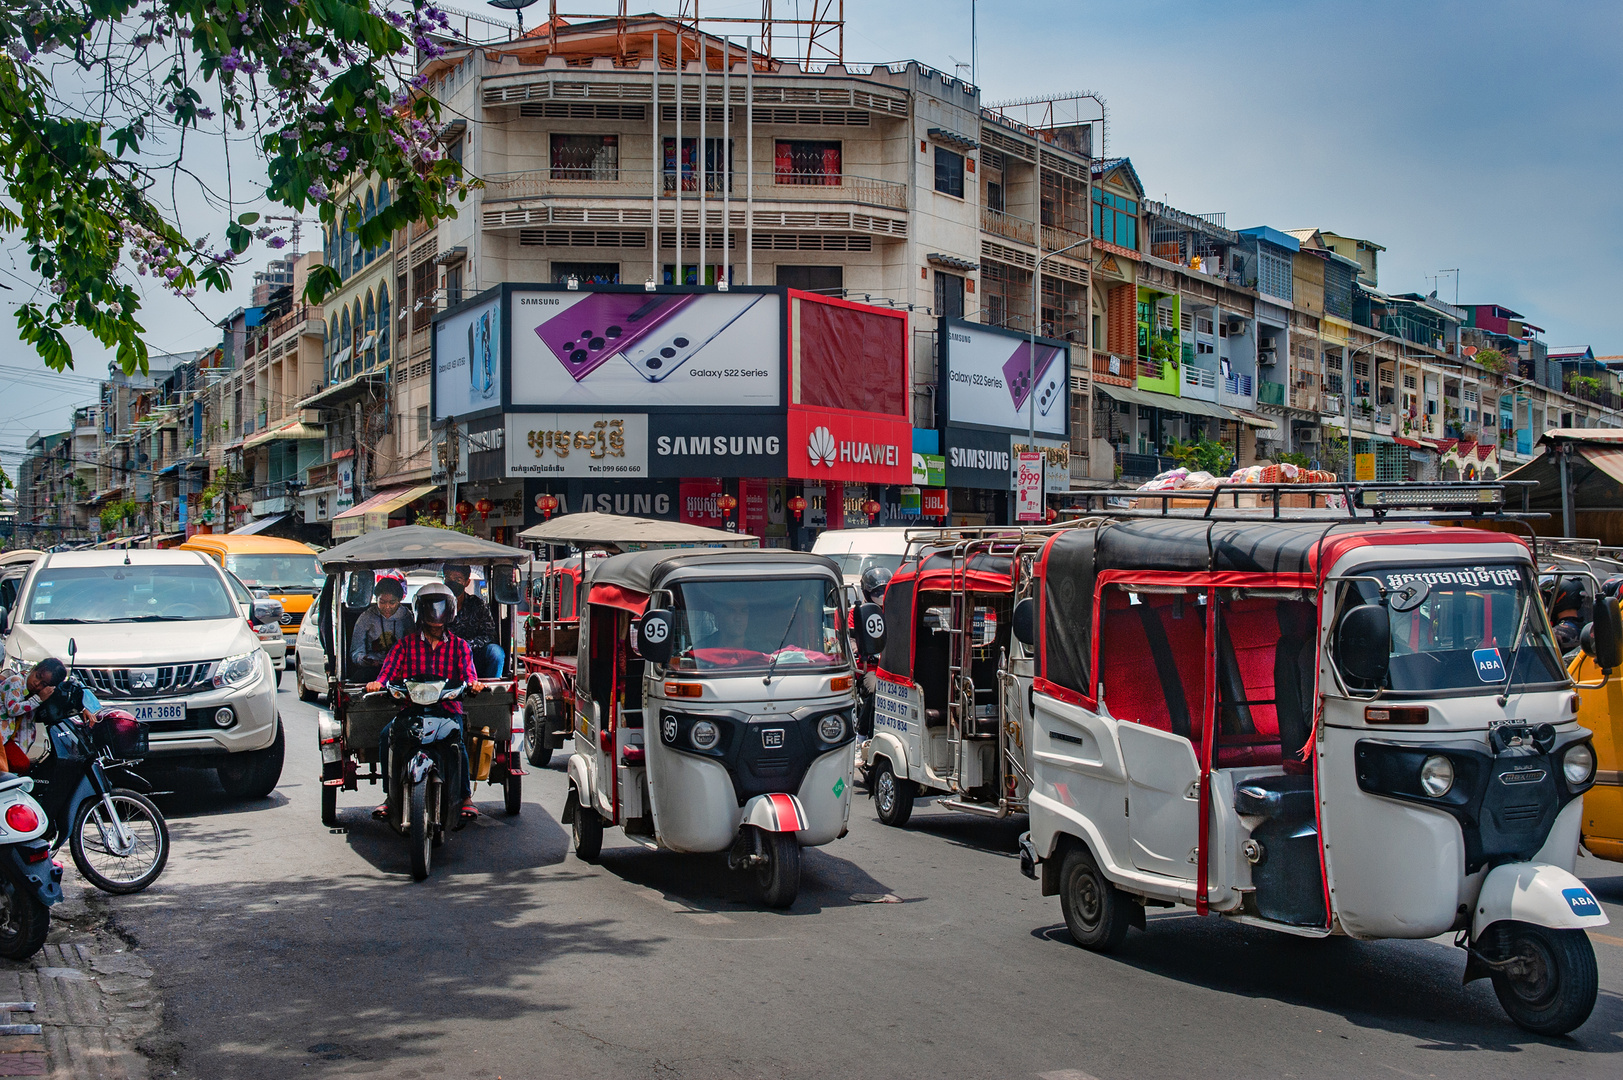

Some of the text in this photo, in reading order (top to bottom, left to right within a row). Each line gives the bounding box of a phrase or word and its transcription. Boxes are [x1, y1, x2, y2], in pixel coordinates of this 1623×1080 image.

[520, 297, 560, 306] SAMSUNG
[948, 332, 971, 344] SAMSUNG
[689, 368, 768, 379] Galaxy S22 Series
[949, 369, 1003, 389] Galaxy S22 Series
[657, 435, 780, 456] SAMSUNG
[839, 441, 899, 466] HUAWEI
[949, 446, 1009, 471] SAMSUNG
[925, 497, 943, 509] JBL
[646, 623, 666, 638] 95
[868, 619, 883, 633] 95
[1479, 660, 1500, 670] ABA
[878, 680, 887, 692] 011
[888, 683, 897, 695] 234
[135, 706, 181, 718] 2AR-3686
[877, 697, 908, 715] 093 590 157
[665, 720, 676, 737] 95
[877, 714, 908, 732] 090 473 834
[1491, 719, 1525, 727] LEXUS
[765, 735, 781, 745] RE
[1571, 896, 1595, 907] ABA
